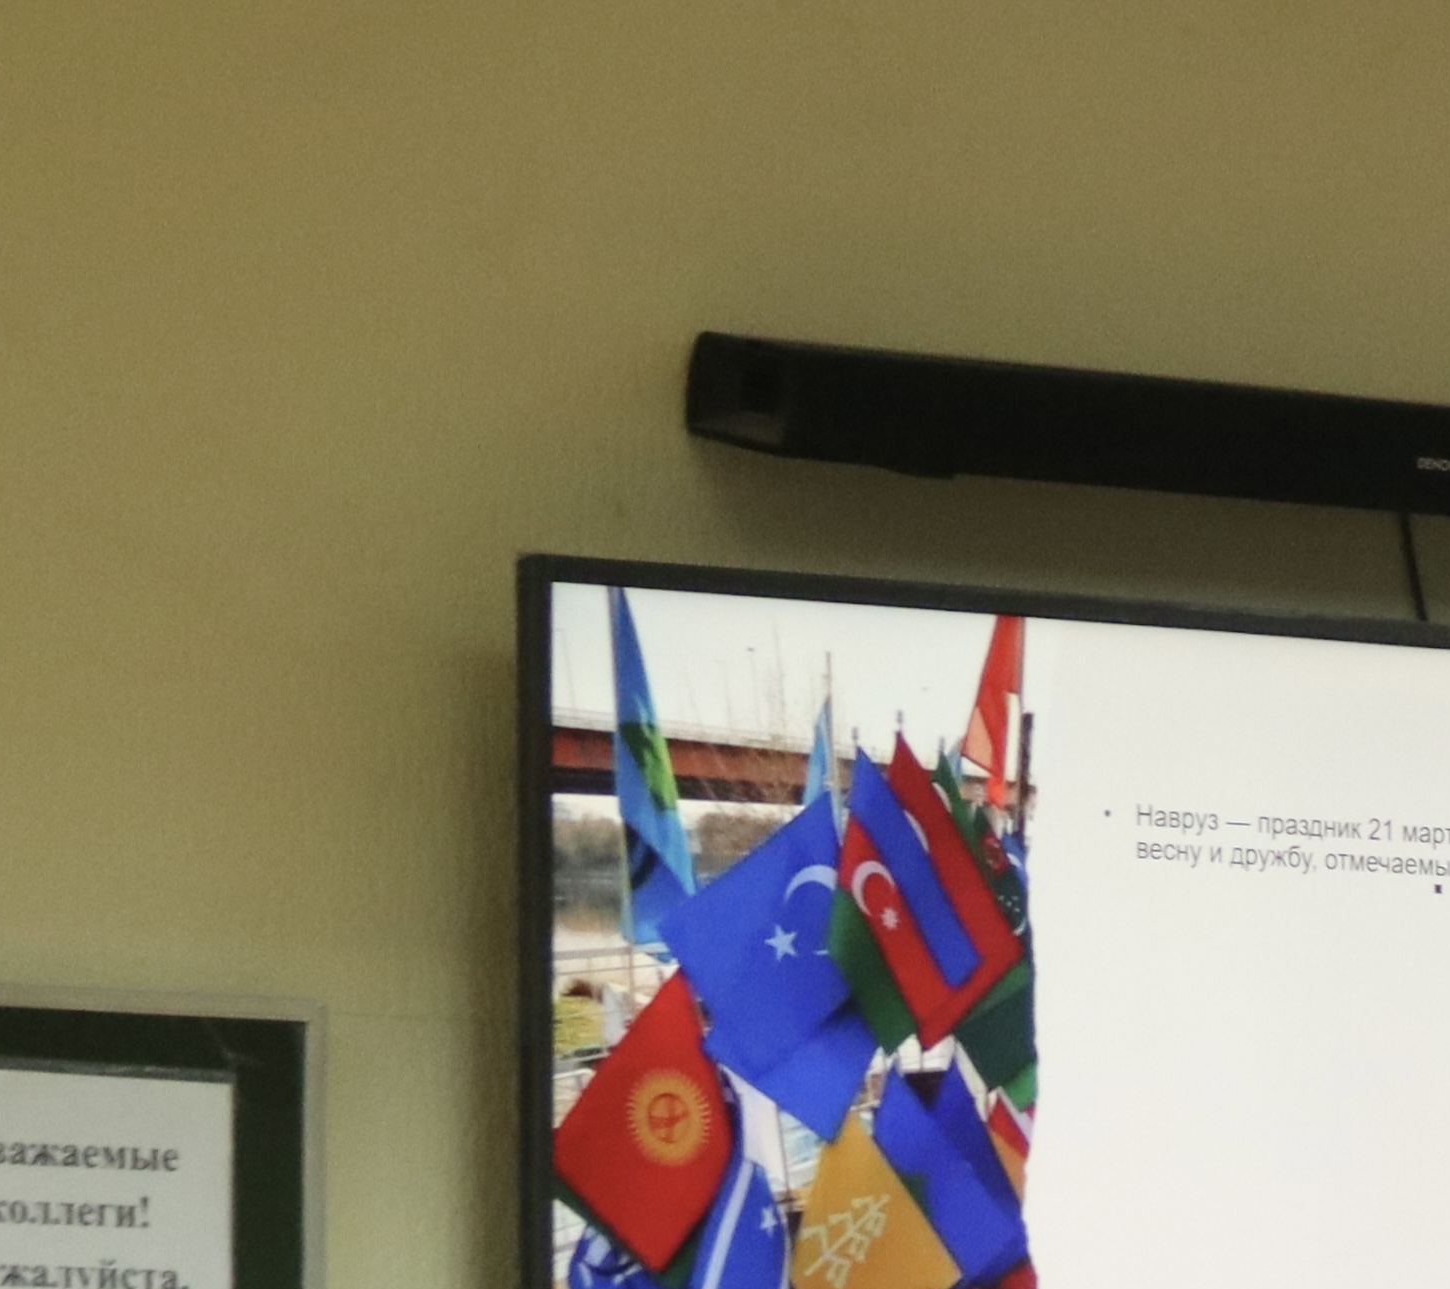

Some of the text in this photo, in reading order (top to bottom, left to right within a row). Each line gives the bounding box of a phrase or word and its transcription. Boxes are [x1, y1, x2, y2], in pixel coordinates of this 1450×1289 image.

[1135, 803, 1220, 836] Навруз
[1257, 814, 1362, 840] праздник
[1367, 817, 1394, 841] 21
[1136, 841, 1201, 868] весну
[1209, 846, 1223, 863] и
[1229, 845, 1317, 874] дружбу,
